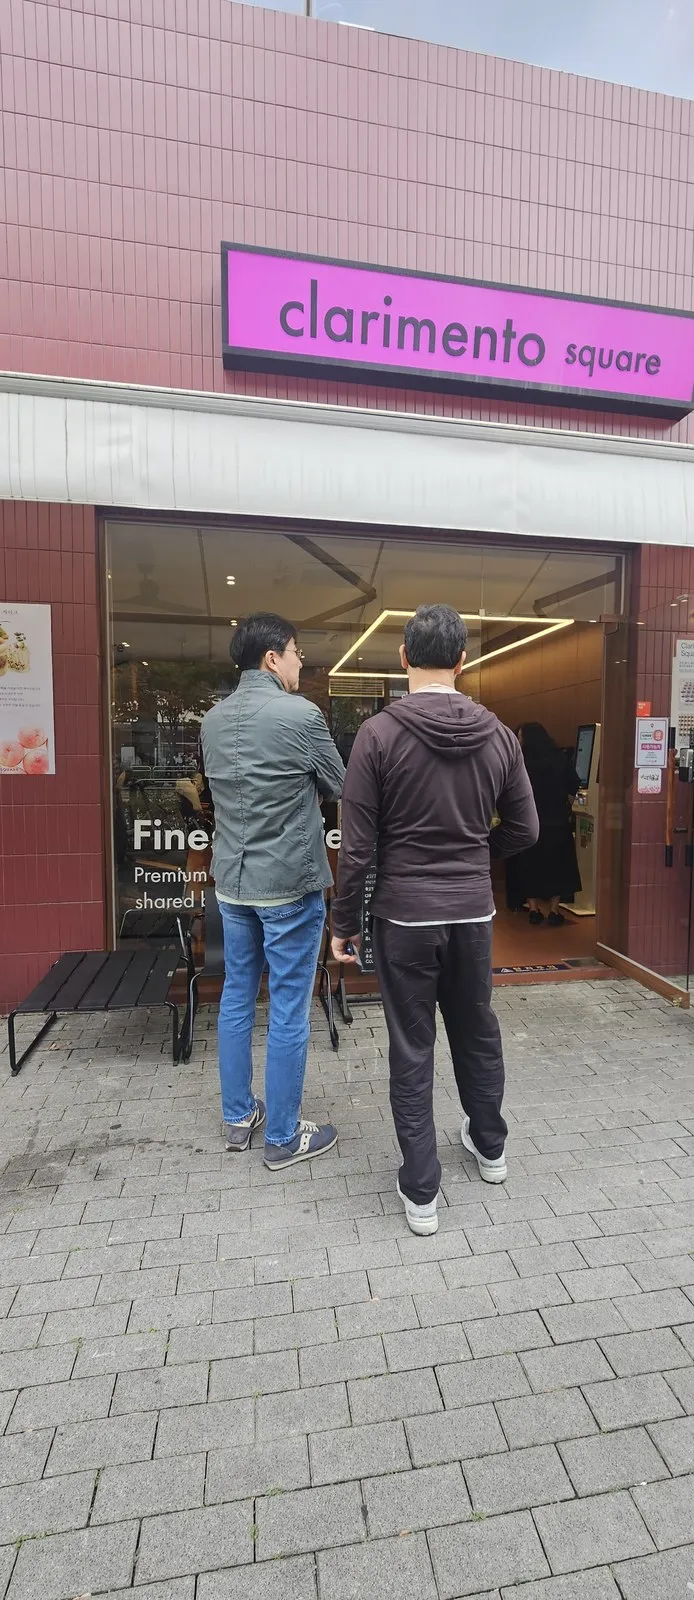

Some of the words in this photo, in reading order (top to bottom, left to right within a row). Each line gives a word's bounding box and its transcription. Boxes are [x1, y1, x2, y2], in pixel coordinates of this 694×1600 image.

[279, 279, 546, 367] clarimento
[564, 341, 661, 377] square
[133, 819, 216, 850] Fine
[134, 867, 207, 883] Premium
[135, 890, 194, 909] shared
